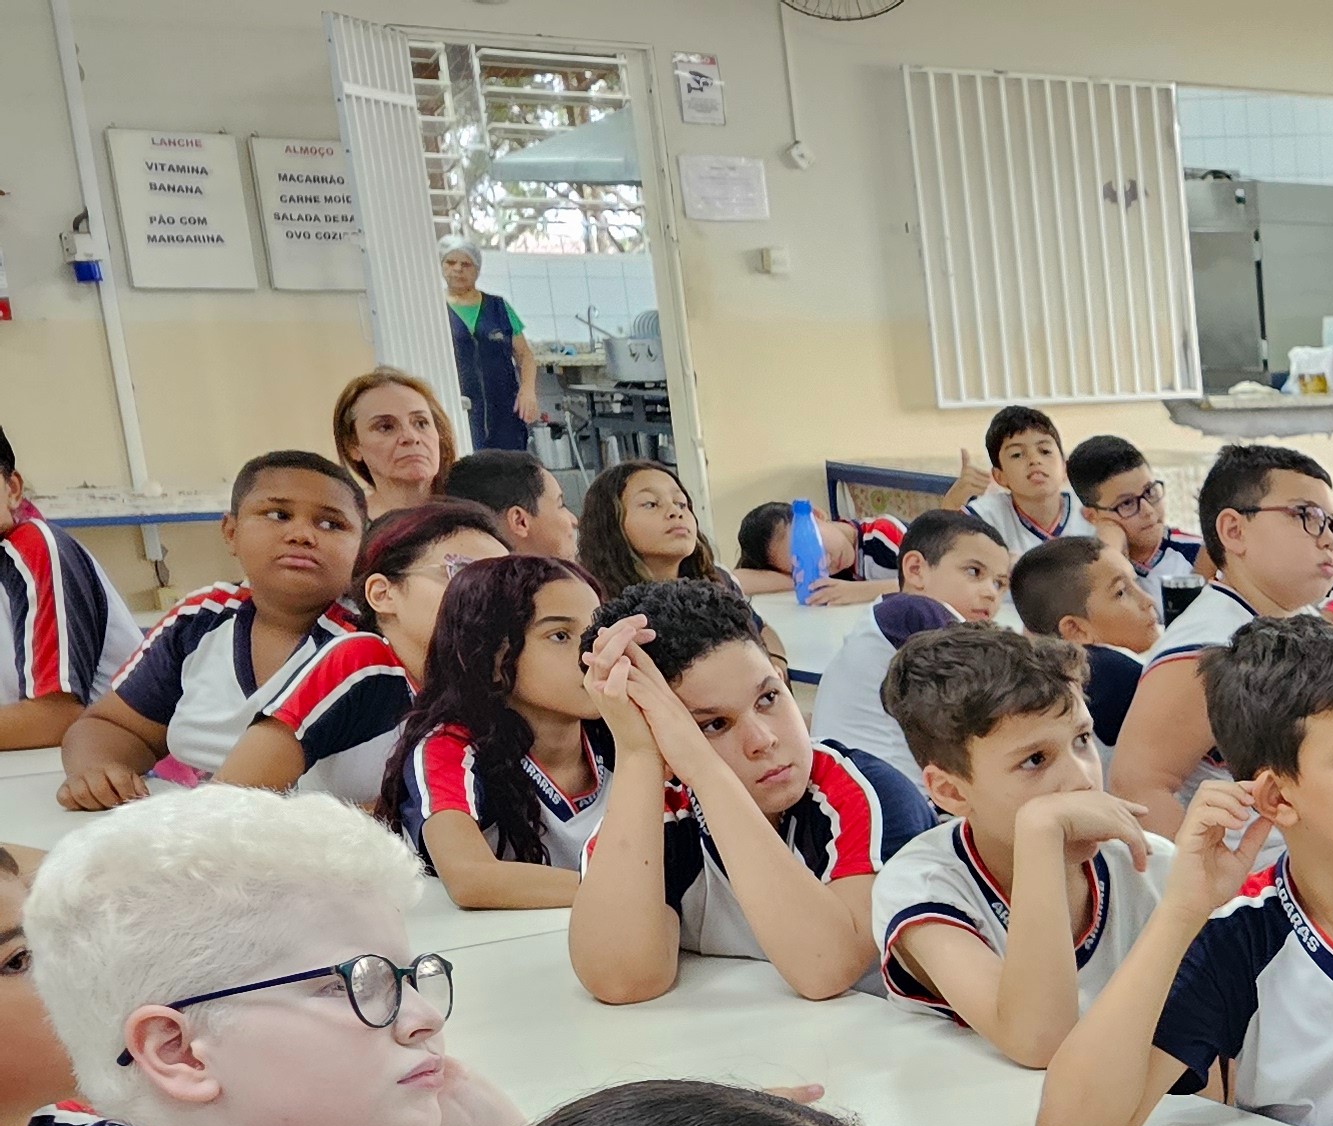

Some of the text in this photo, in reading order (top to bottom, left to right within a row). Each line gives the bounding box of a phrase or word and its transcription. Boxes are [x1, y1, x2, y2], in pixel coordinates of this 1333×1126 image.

[151, 137, 203, 148] LANCHE
[284, 145, 334, 158] ALMOÇO
[145, 161, 208, 176] VITAMINA
[278, 173, 345, 186] MACARRÃO
[149, 181, 203, 195] BANANA
[279, 194, 321, 205] CARNE
[149, 214, 208, 226] PÃO COM
[273, 212, 321, 223] SALADA
[146, 234, 225, 244] MARGARINA
[285, 230, 311, 240] OVO
[1275, 877, 1319, 953] ARARAS
